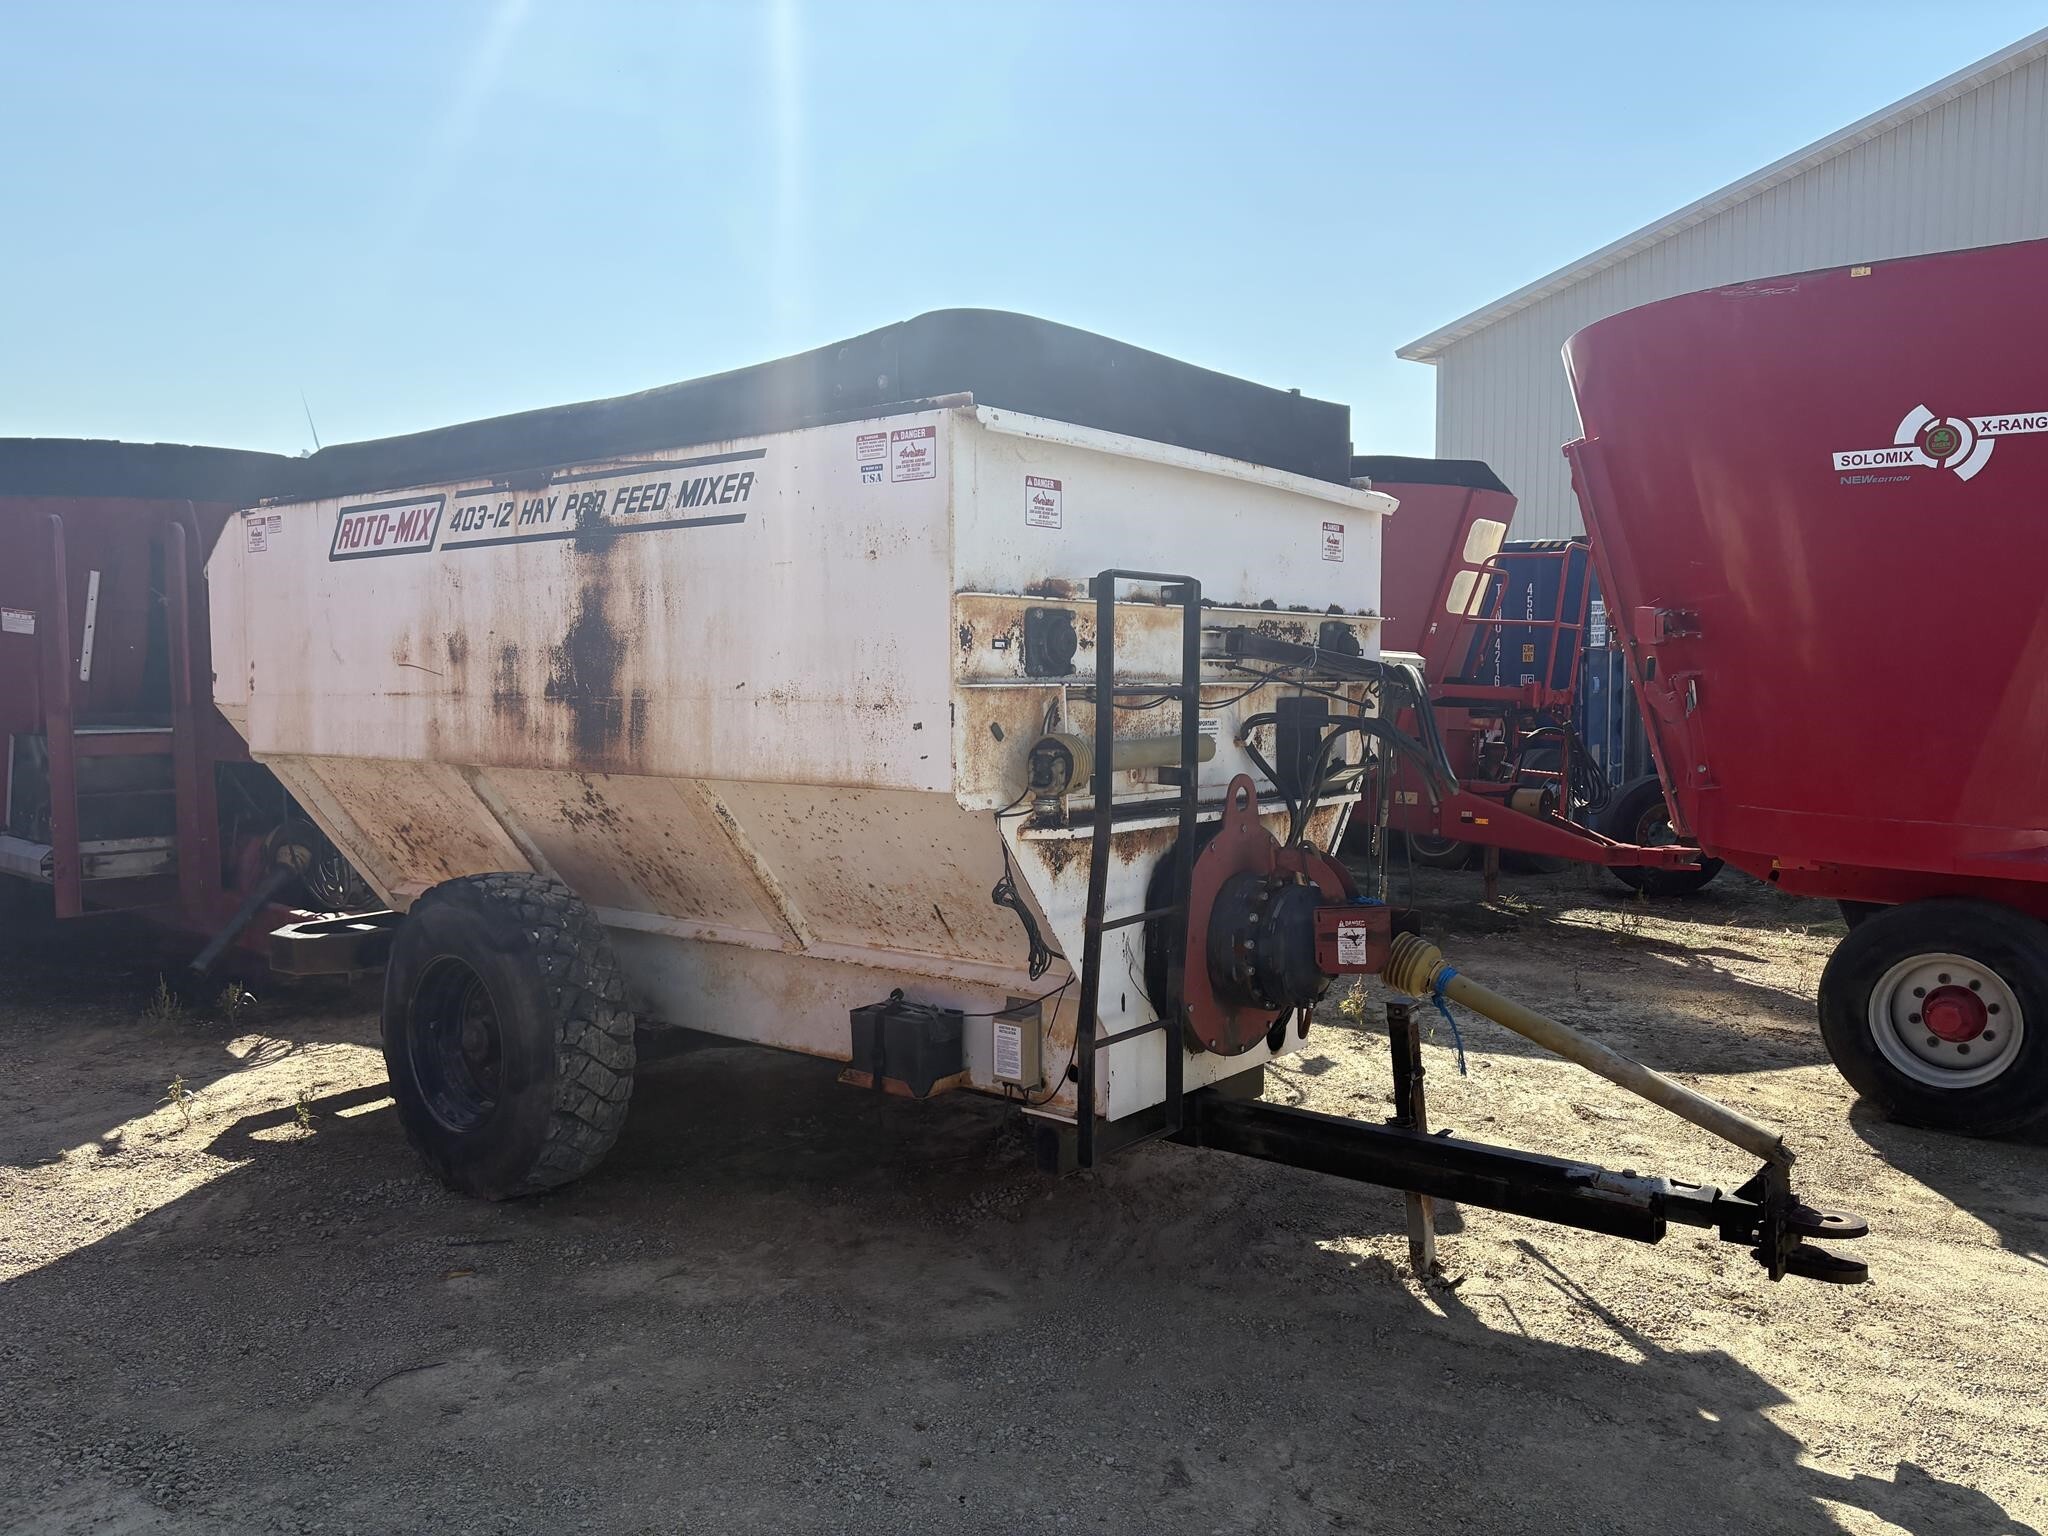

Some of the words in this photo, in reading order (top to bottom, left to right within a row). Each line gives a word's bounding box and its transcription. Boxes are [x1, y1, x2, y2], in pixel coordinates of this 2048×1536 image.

[901, 428, 926, 440] DANGER
[1841, 450, 1913, 466] SOLOMIX
[863, 473, 882, 484] USA
[450, 502, 514, 532] 403-12
[518, 496, 558, 525] HAY
[611, 482, 671, 515] FEED
[675, 471, 755, 508] MIXER
[337, 508, 436, 549] ROTO-MIX
